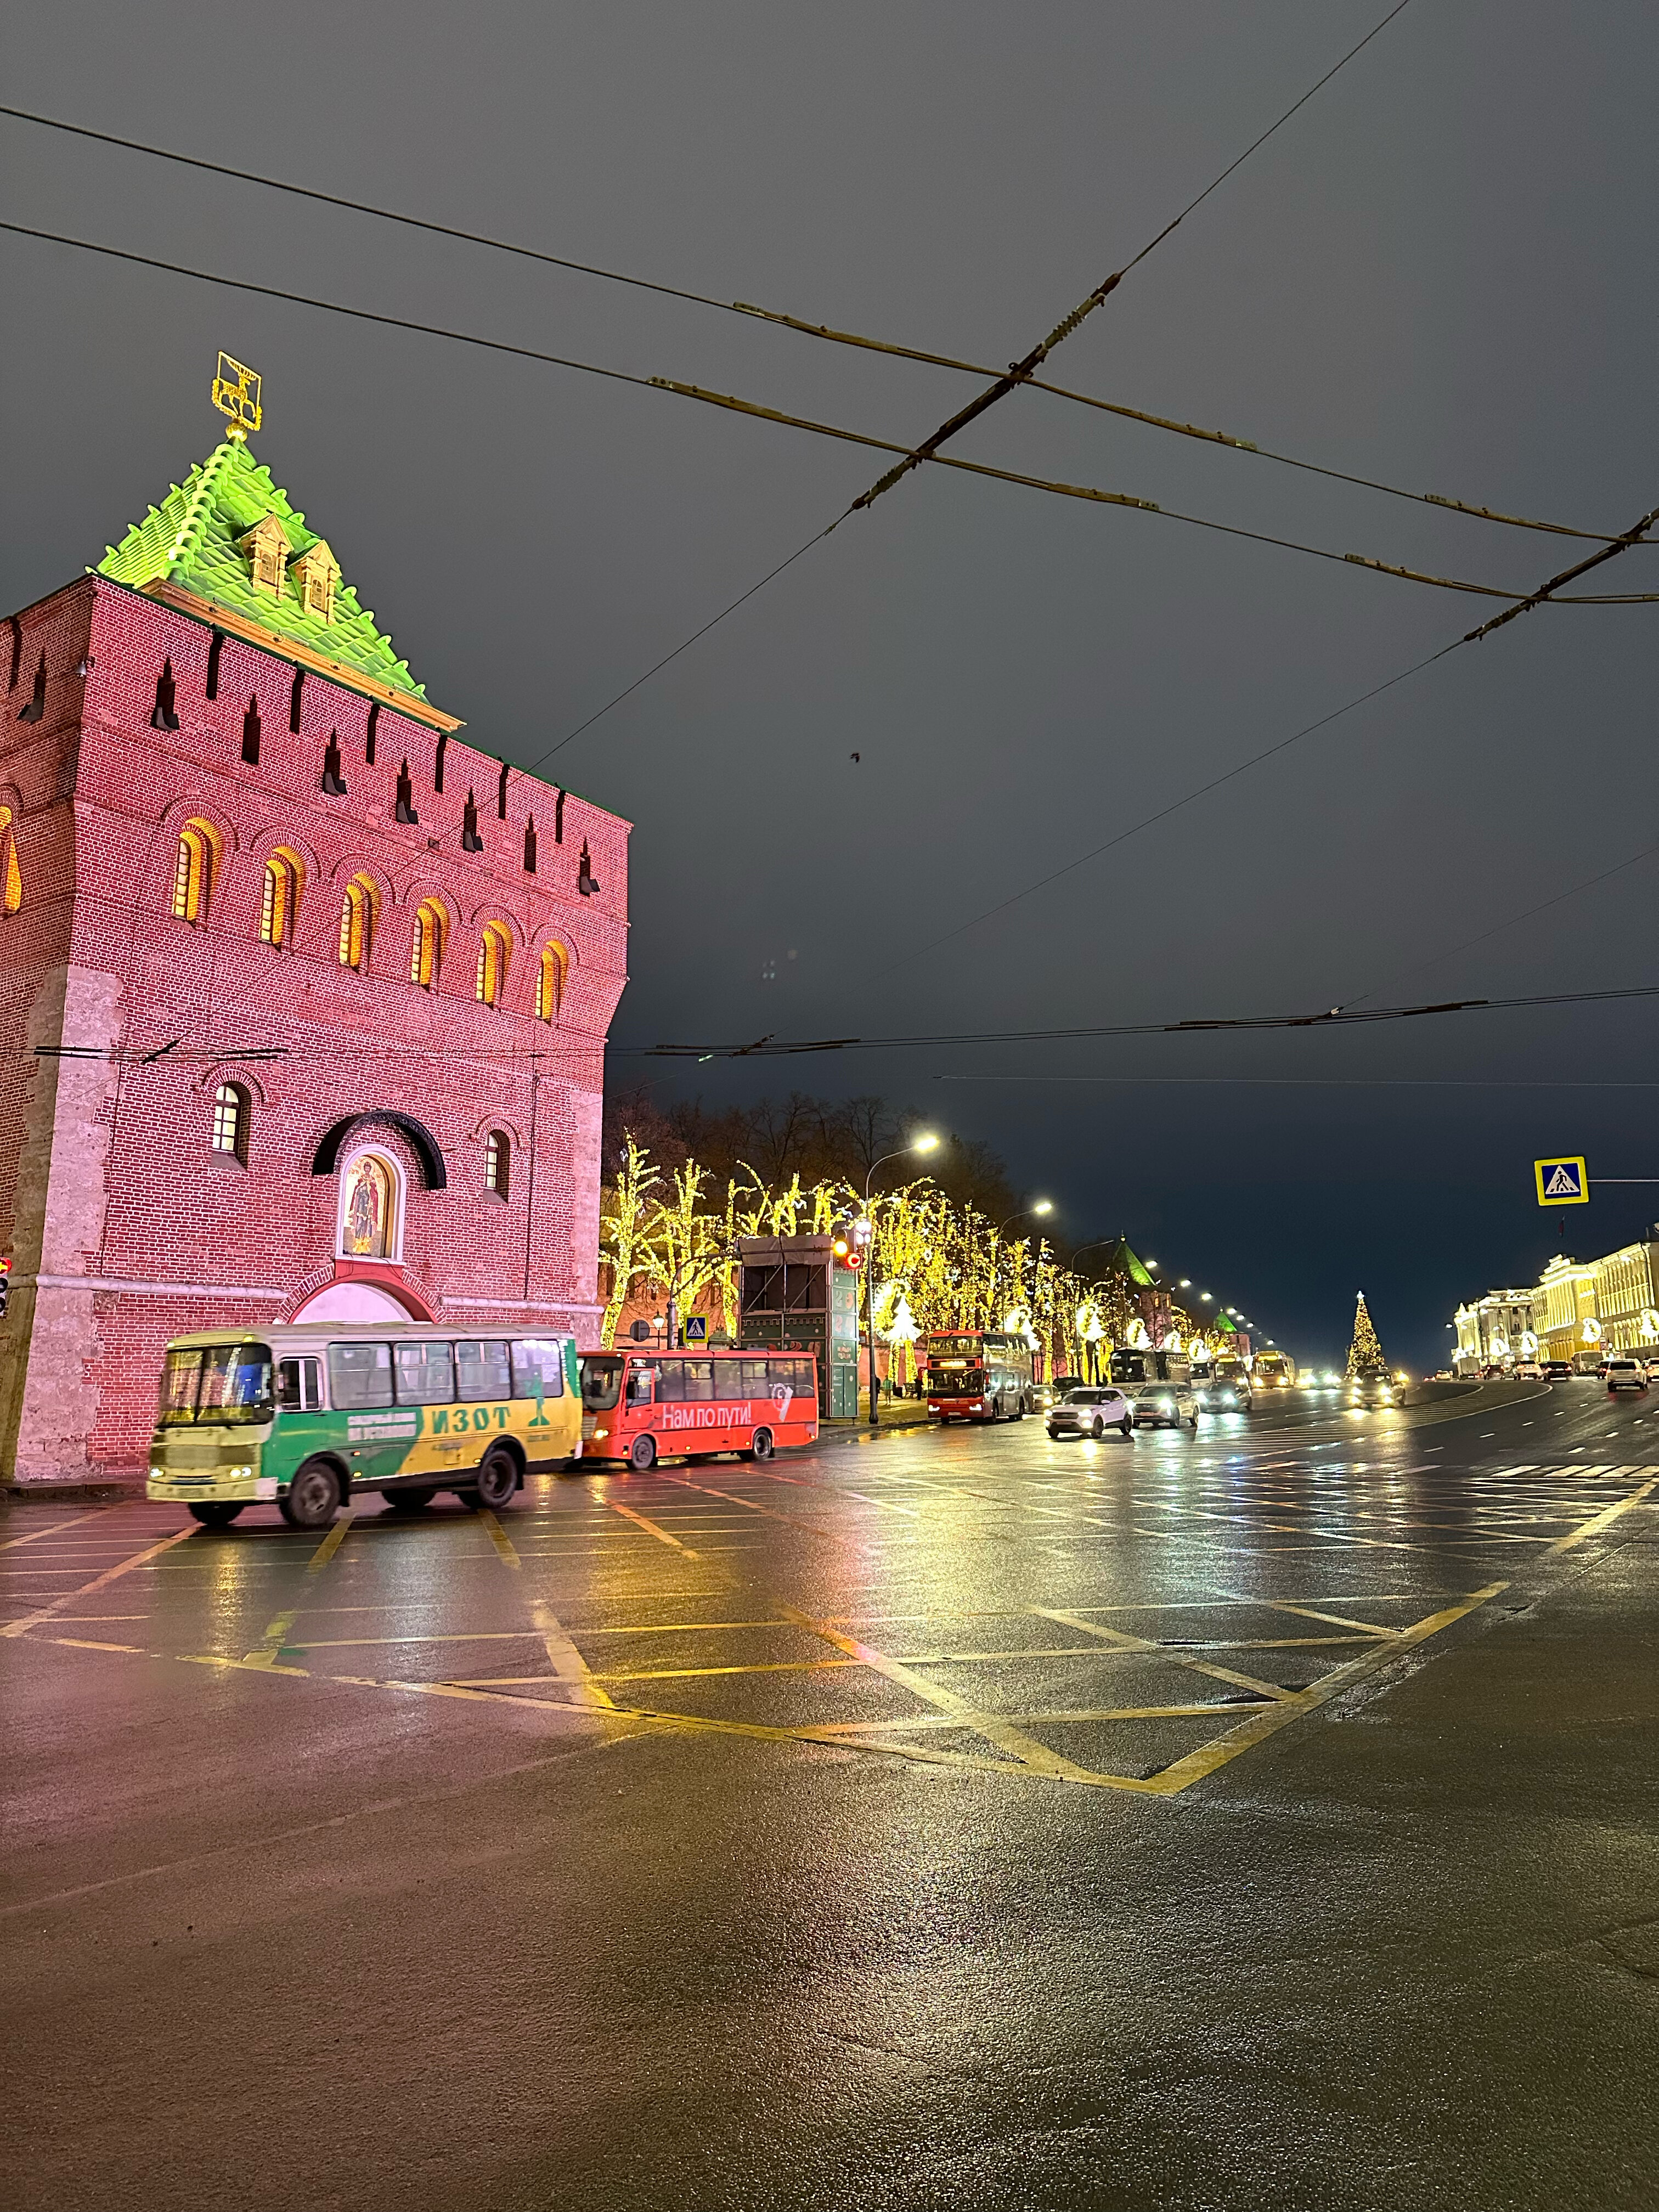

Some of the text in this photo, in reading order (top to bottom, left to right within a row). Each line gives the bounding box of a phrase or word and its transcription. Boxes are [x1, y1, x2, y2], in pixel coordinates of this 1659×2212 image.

[432, 1407, 511, 1434] ИЗОТ
[663, 1402, 751, 1431] Нам по пути!
